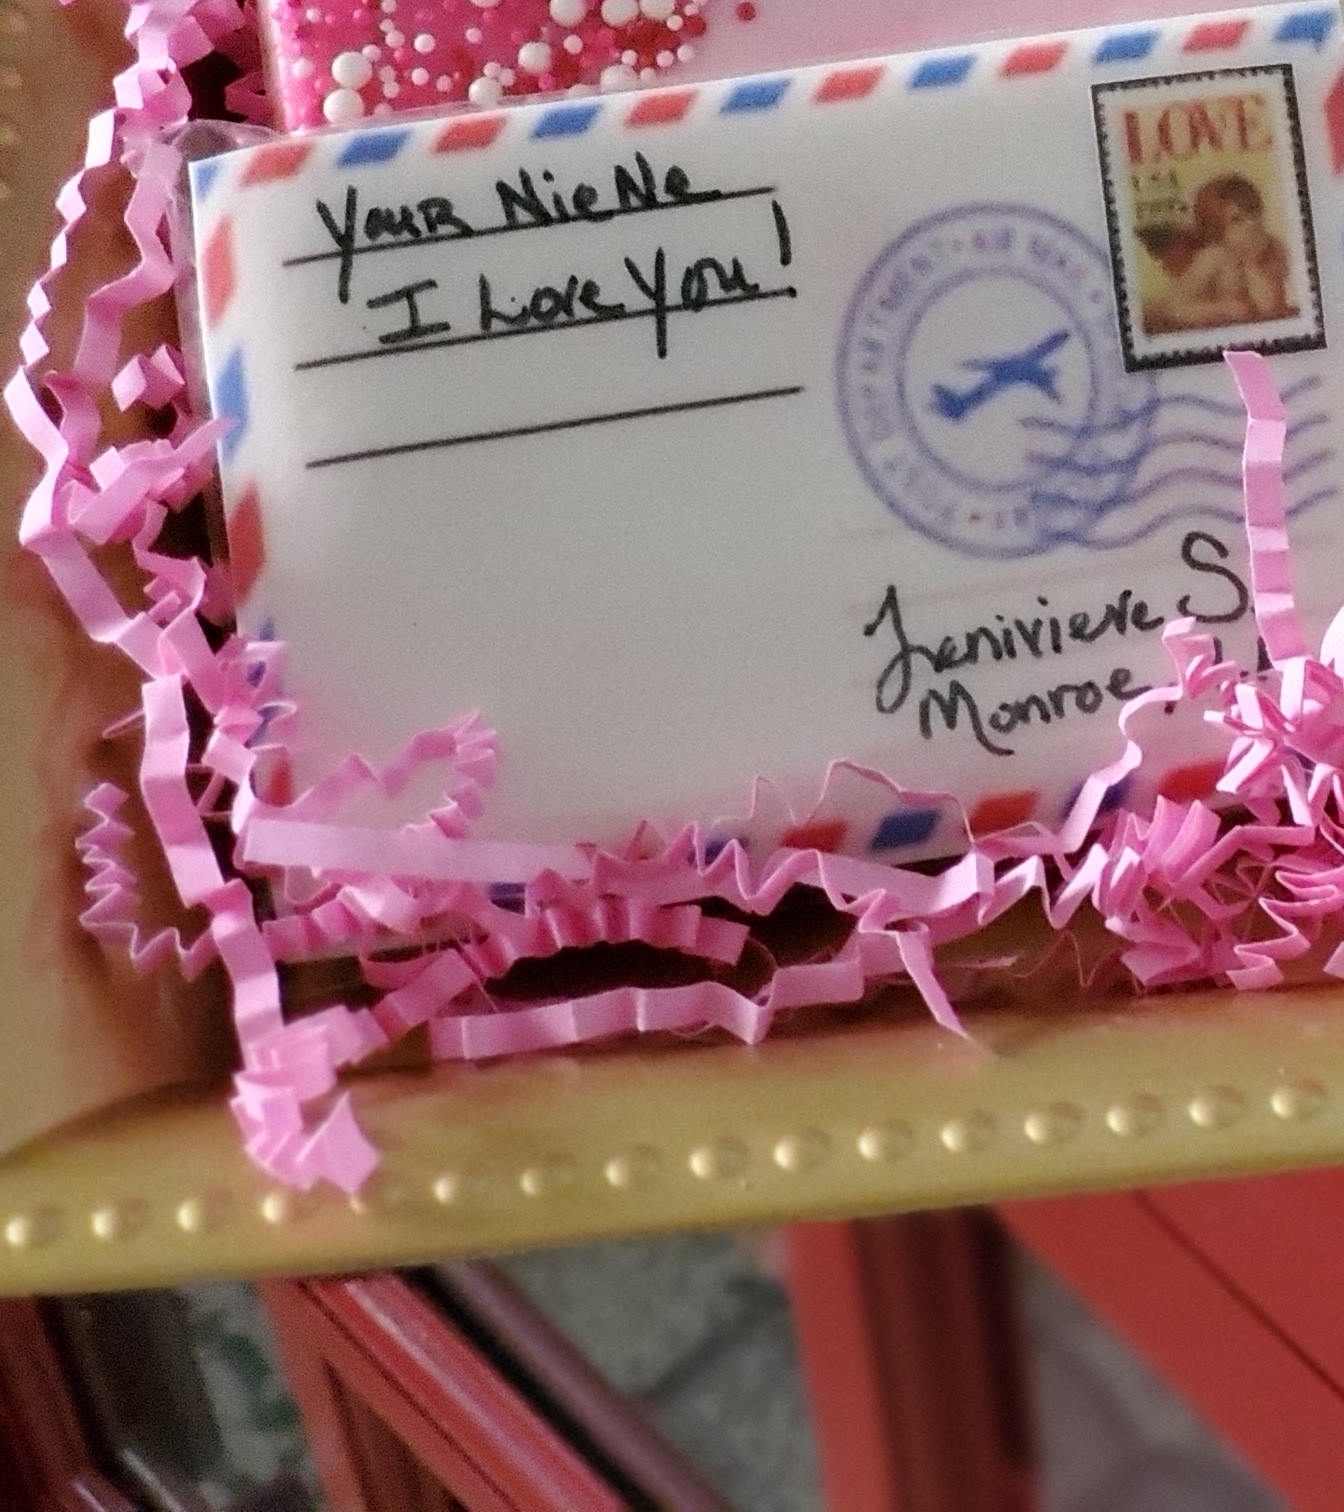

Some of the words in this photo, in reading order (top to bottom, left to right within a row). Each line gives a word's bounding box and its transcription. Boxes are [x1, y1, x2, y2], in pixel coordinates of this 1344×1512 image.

[1122, 92, 1276, 166] LOVE
[366, 278, 451, 345] I
[479, 272, 626, 333] Love
[918, 666, 1153, 757] Monroe
